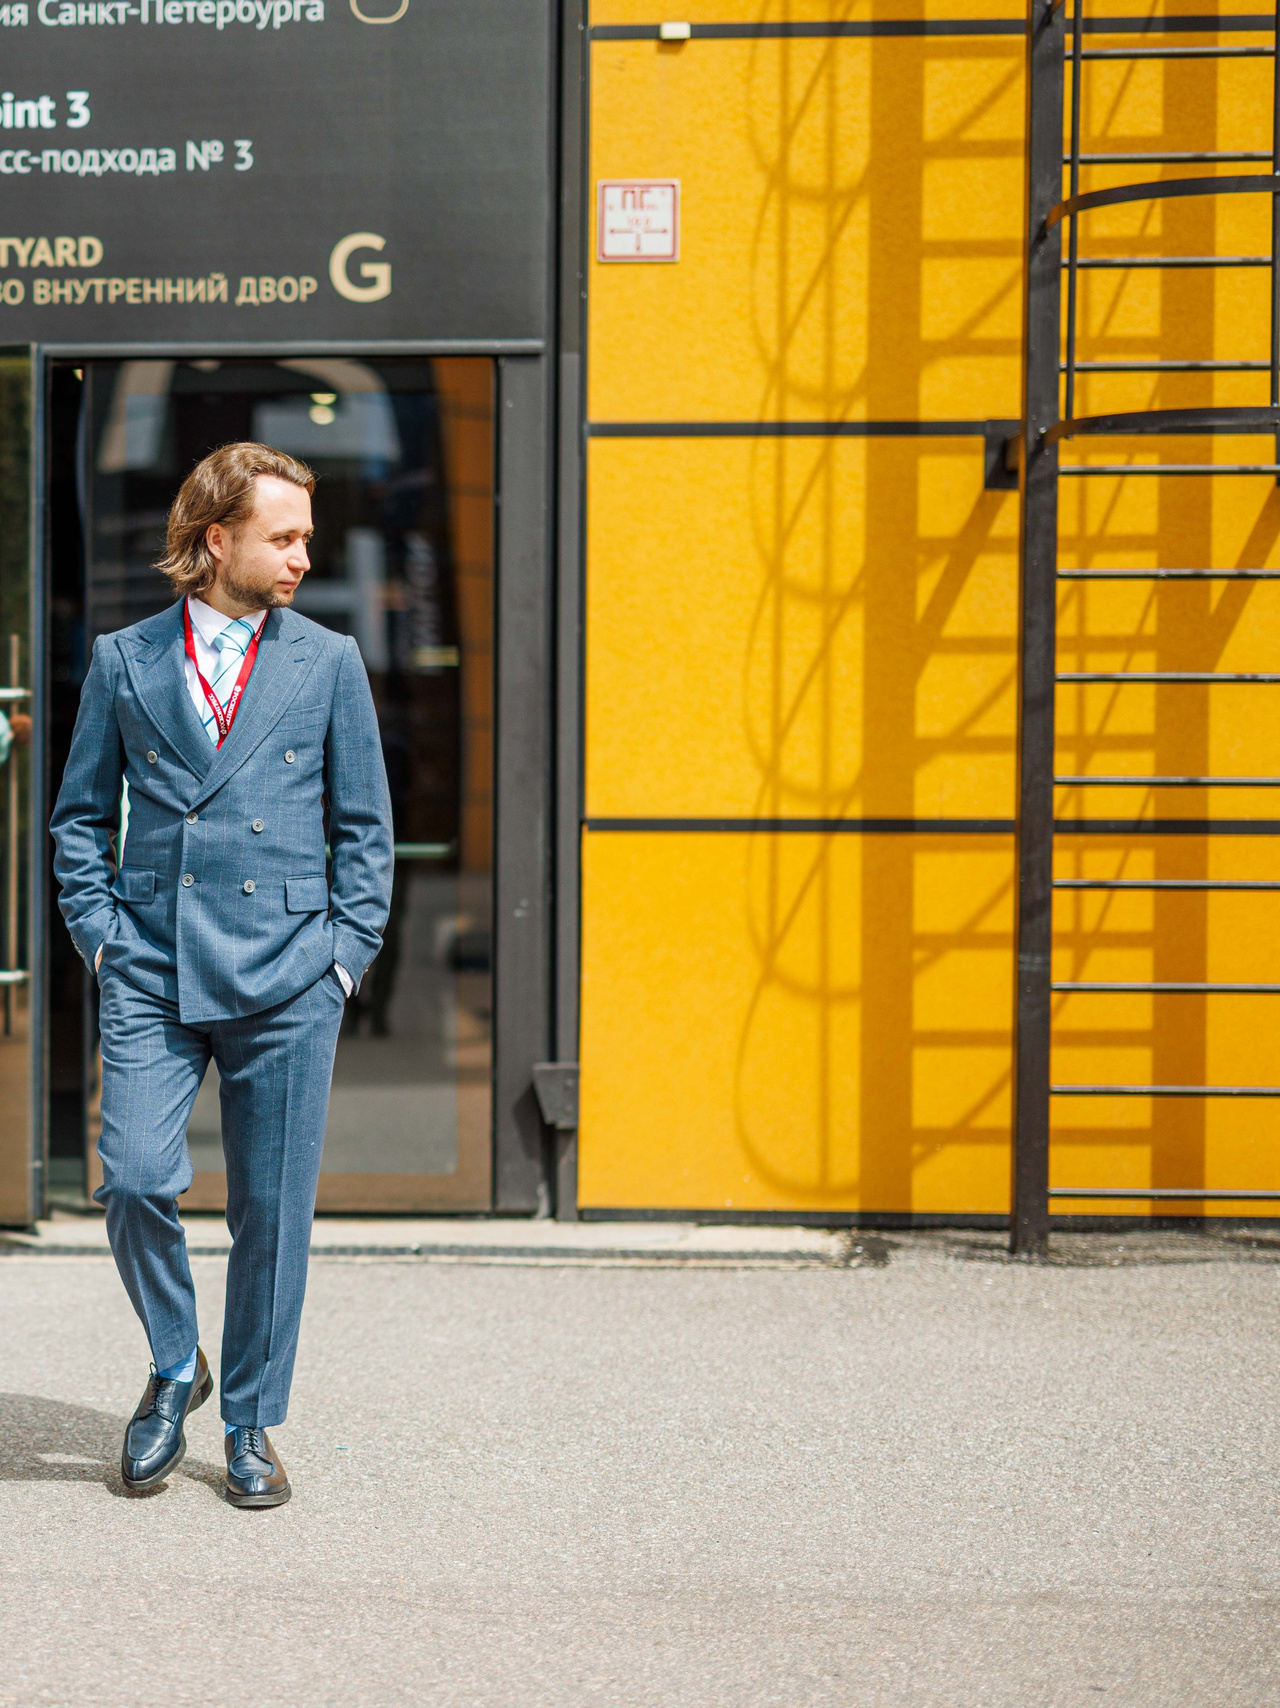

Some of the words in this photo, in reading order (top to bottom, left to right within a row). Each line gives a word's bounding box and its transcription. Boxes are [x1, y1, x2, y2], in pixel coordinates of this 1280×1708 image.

[37, 0, 325, 30] Санкт-Петербурга
[66, 91, 91, 128] 3
[186, 139, 224, 171] №
[233, 140, 254, 171] 3
[329, 232, 392, 303] G
[33, 272, 228, 305] ВНУТРЕННИЙ
[234, 276, 318, 307] ДВОР
